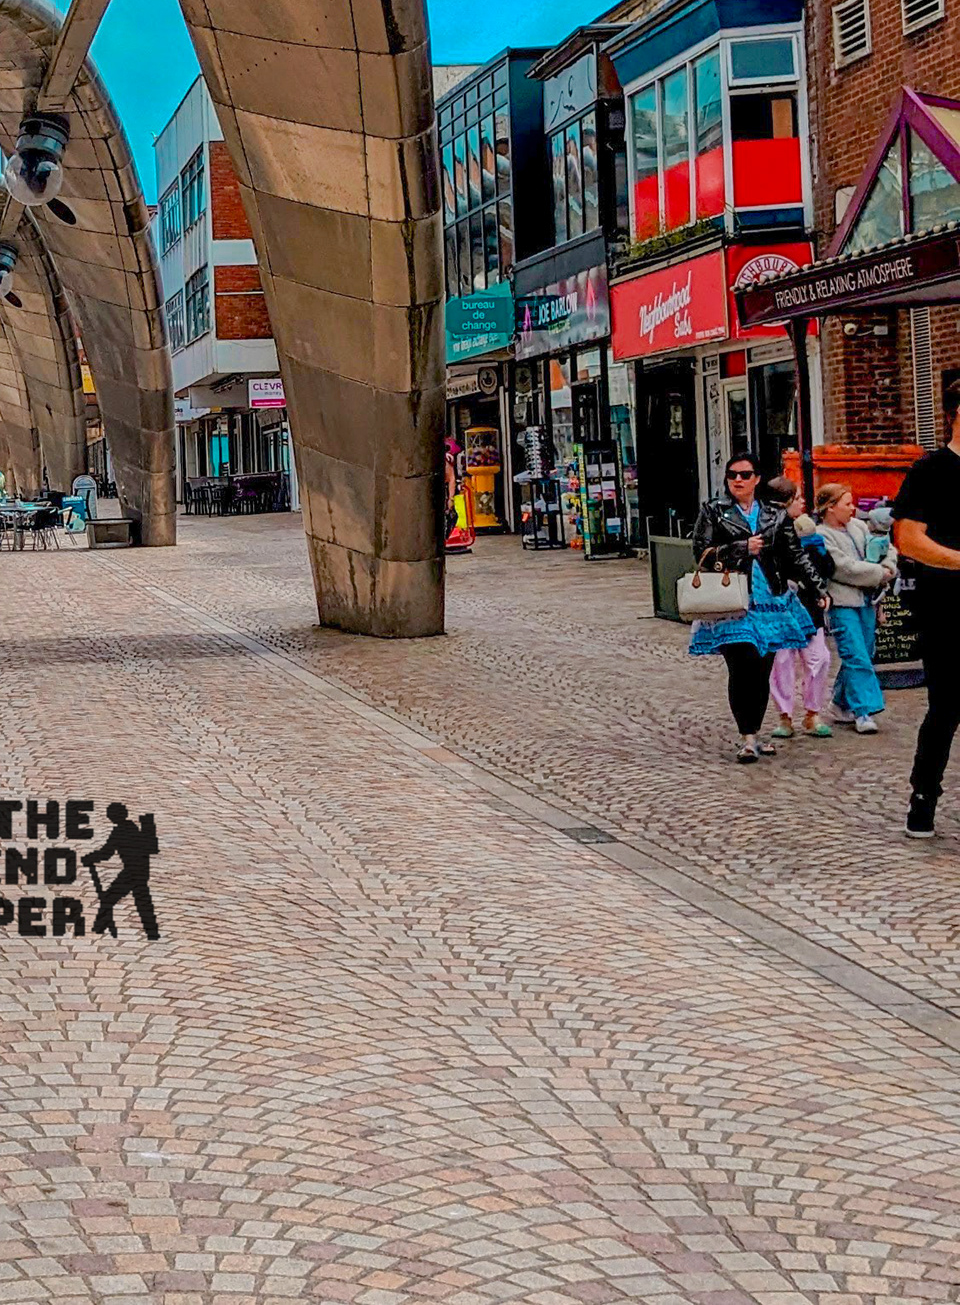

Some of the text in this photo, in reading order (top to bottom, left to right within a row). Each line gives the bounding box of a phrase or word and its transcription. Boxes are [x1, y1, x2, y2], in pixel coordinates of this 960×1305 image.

[775, 256, 914, 310] FRIENDLY & RELAXING ATMOSPHERE
[462, 301, 495, 310] bureau
[472, 310, 485, 319] de
[538, 292, 578, 325] JOE BARLOW
[639, 270, 692, 345] Neighbourhood
[462, 321, 496, 331] change
[674, 309, 693, 339] Subs
[252, 382, 282, 391] CLEVR
